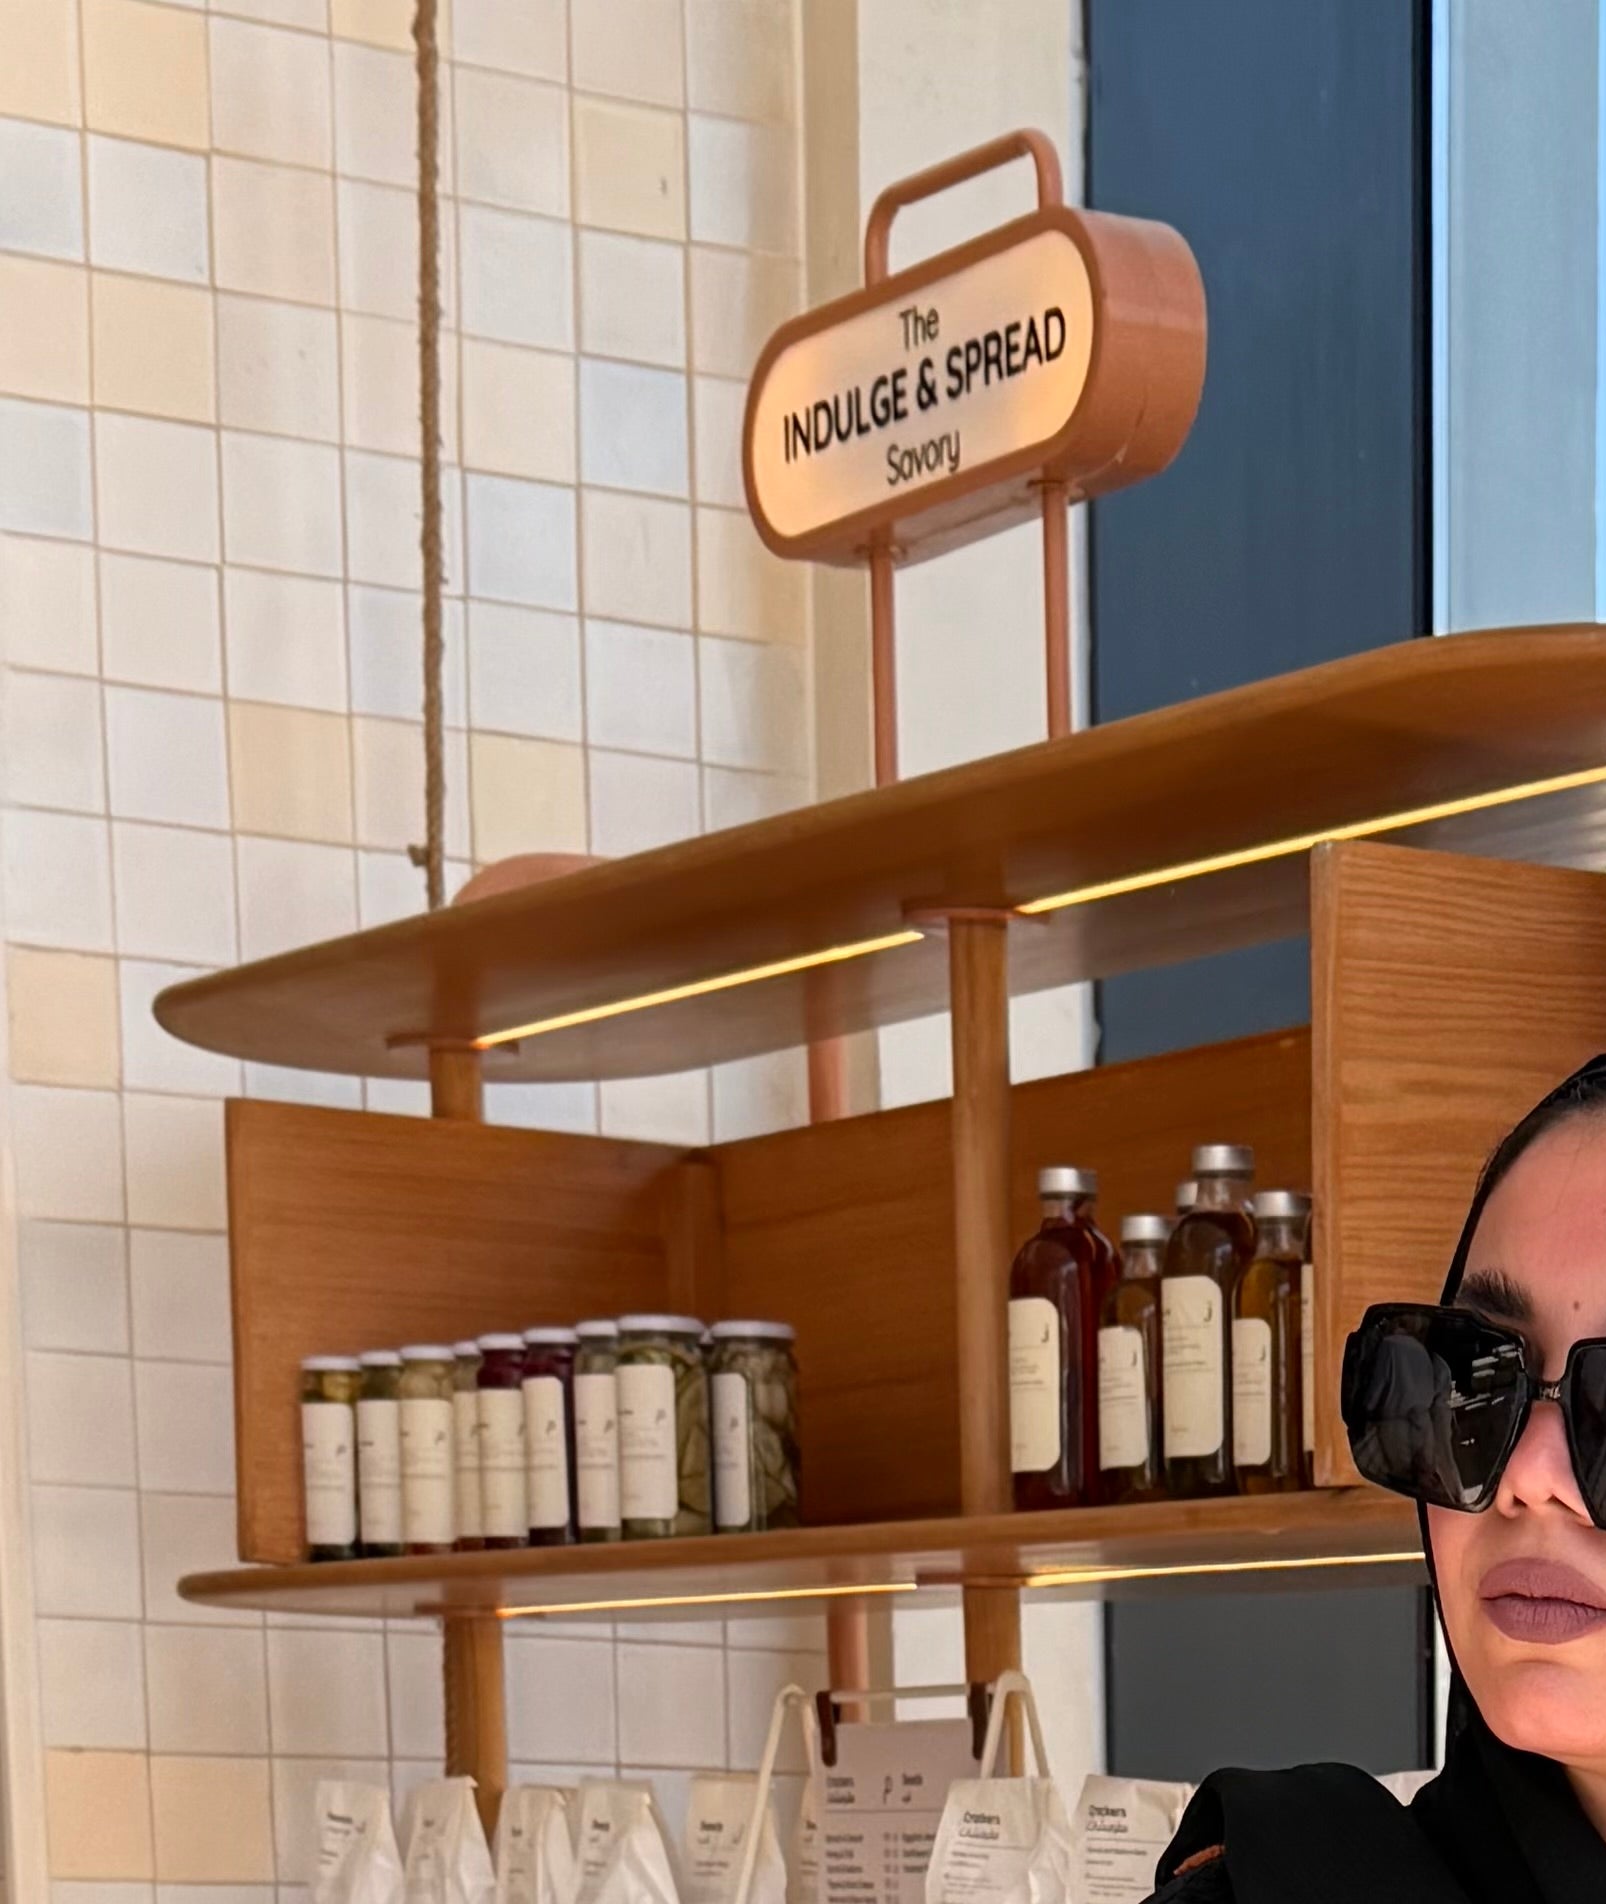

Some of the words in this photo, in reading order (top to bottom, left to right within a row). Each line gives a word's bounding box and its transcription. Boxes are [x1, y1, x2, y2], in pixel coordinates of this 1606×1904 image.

[899, 305, 940, 351] The
[783, 367, 909, 464] INDULGE
[916, 356, 938, 411] &
[946, 306, 1067, 399] SPREAD
[886, 430, 961, 486] Savory
